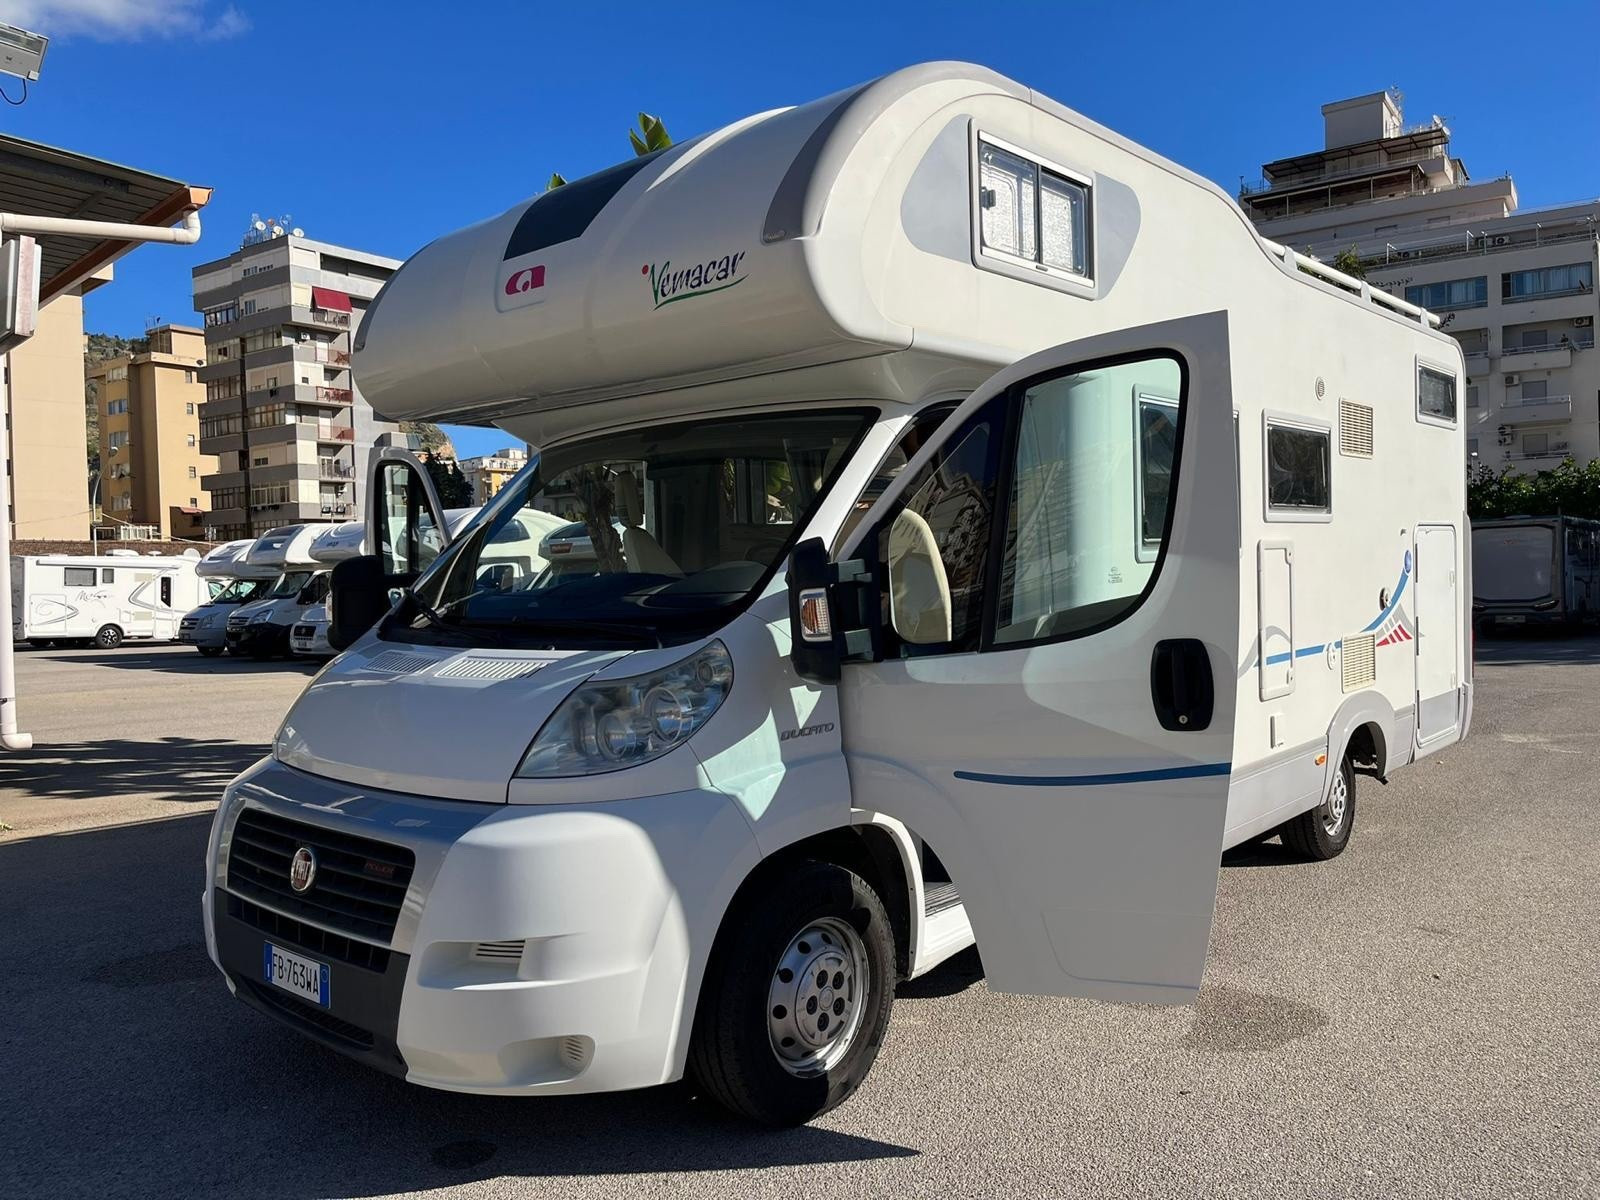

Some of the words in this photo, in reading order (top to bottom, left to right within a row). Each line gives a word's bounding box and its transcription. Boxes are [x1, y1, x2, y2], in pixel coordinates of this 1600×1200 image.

[648, 250, 746, 305] Vemacar
[780, 722, 835, 742] DUCATO
[294, 859, 311, 881] FIAT
